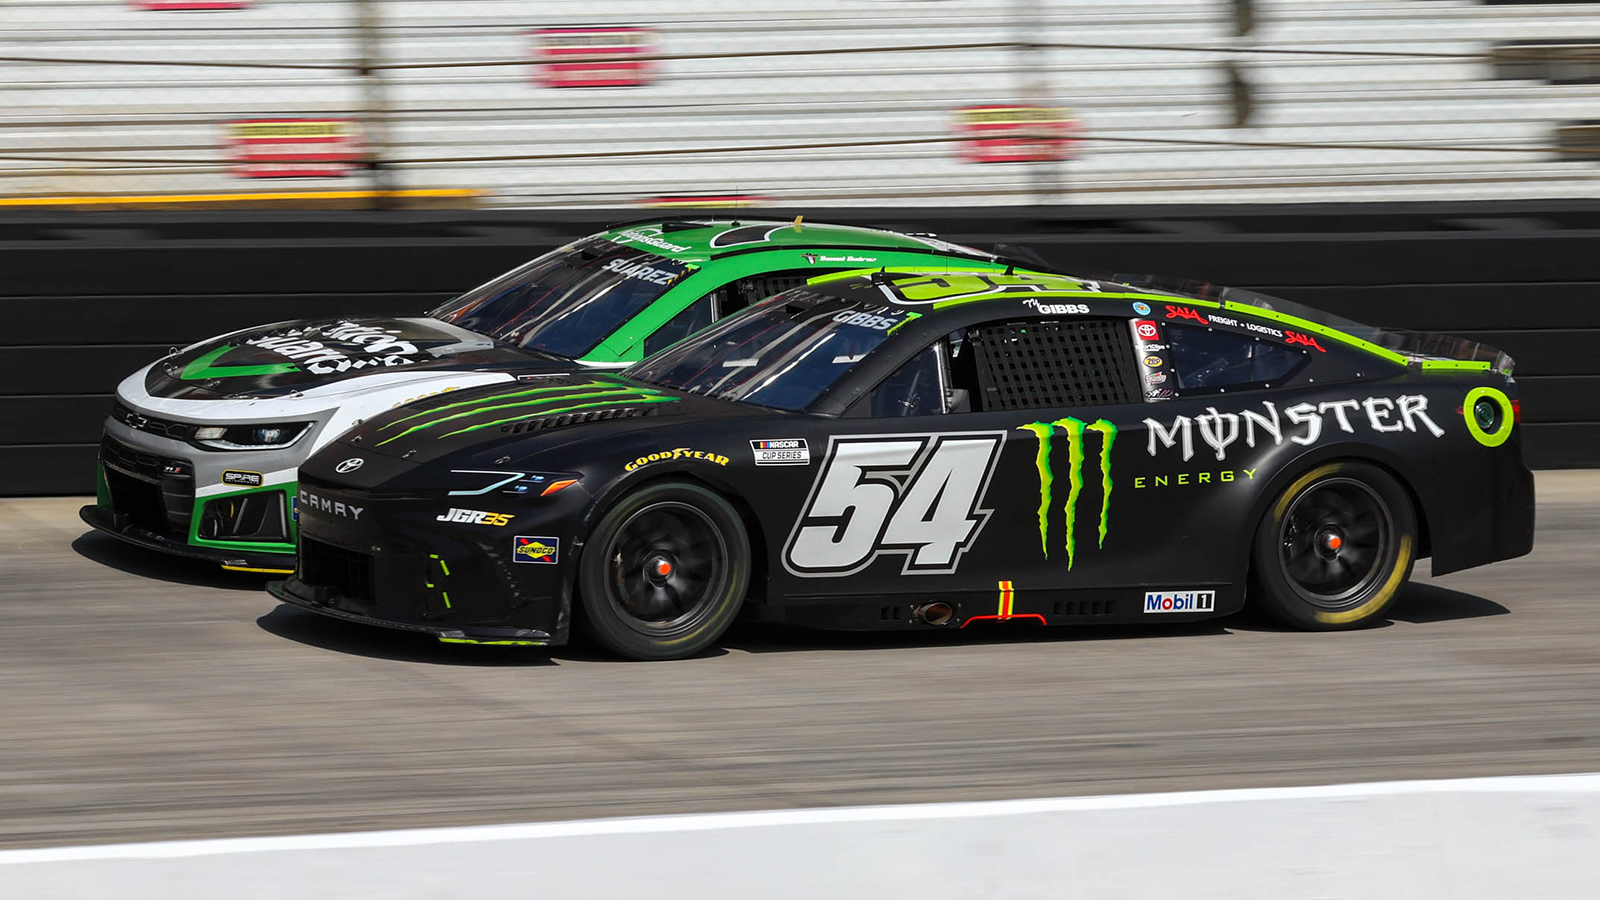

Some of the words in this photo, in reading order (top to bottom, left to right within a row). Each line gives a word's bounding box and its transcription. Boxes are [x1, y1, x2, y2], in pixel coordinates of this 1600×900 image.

[1038, 304, 1091, 315] GIBBS
[832, 310, 898, 331] GIBBS
[1165, 305, 1209, 325] SAIA
[1207, 314, 1238, 327] FREIGHT
[1246, 322, 1283, 338] LOGISTICS
[1142, 395, 1445, 461] MONSTER
[762, 451, 776, 460] CUP
[777, 450, 802, 460] SERIES
[769, 440, 799, 449] NASCAR
[624, 447, 731, 472] GOODYEAR
[1134, 468, 1257, 489] ENERGY
[781, 430, 1008, 578] 54
[518, 545, 556, 555] SUNOCO
[1146, 593, 1194, 610] Mobil
[1200, 594, 1207, 609] 1
